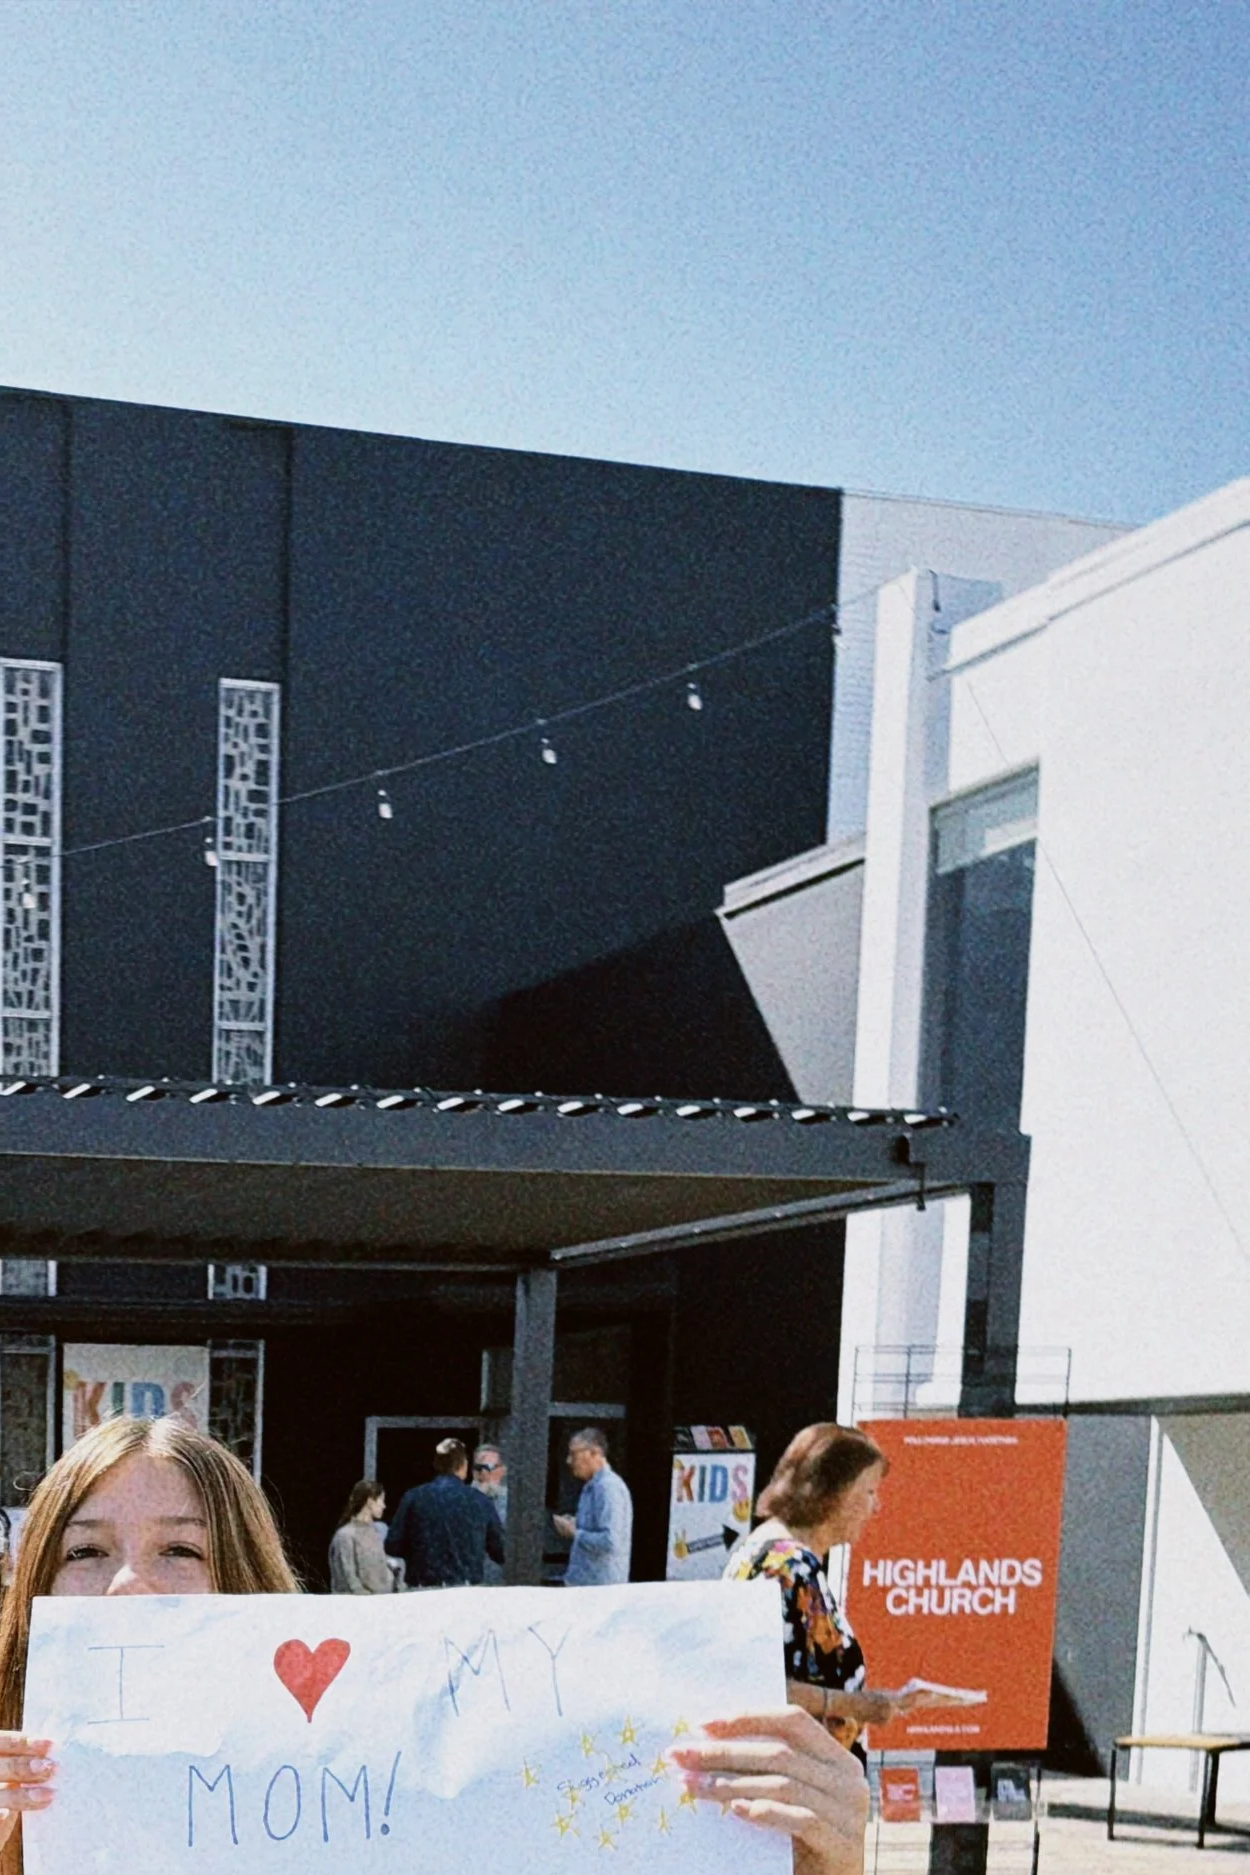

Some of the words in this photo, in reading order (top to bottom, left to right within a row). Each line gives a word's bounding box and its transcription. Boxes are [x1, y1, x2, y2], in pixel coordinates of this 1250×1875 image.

[676, 1464, 749, 1503] KIDS
[862, 1558, 1043, 1587] HIGHLANDS
[885, 1586, 1017, 1616] CHURCH
[87, 1644, 165, 1725] I
[444, 1626, 571, 1717] MY
[187, 1751, 402, 1847] MOM!
